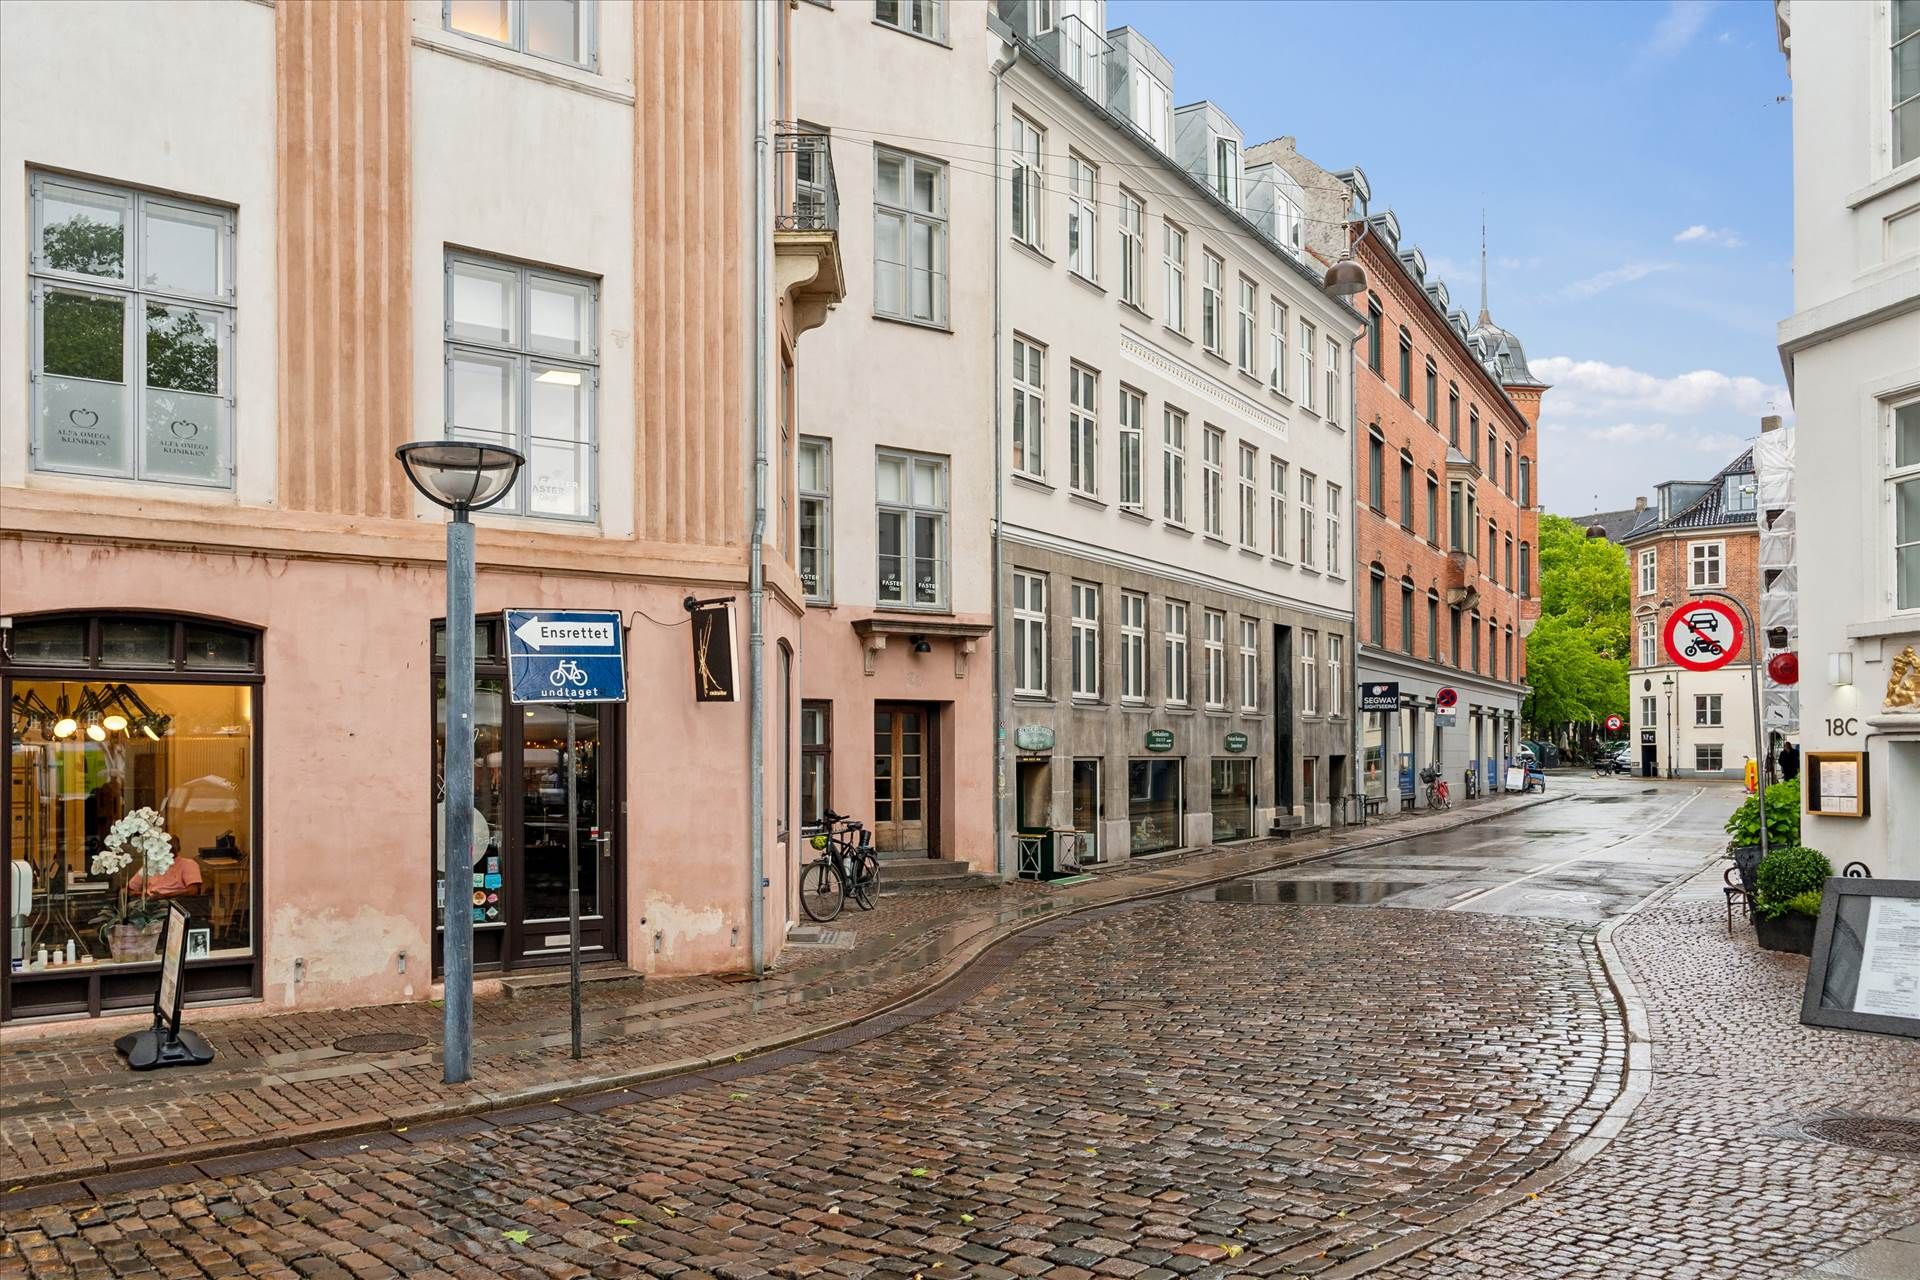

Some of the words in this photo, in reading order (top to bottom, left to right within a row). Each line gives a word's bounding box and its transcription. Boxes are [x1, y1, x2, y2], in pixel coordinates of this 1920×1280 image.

[80, 431, 111, 440] OMEGA
[61, 436, 107, 446] KLINIKKEN
[180, 442, 209, 450] OMEGA
[163, 447, 206, 457] KLINIKKEN
[541, 627, 608, 639] Ensrettet
[541, 687, 599, 698] undtaget
[1824, 717, 1858, 737] 18C
